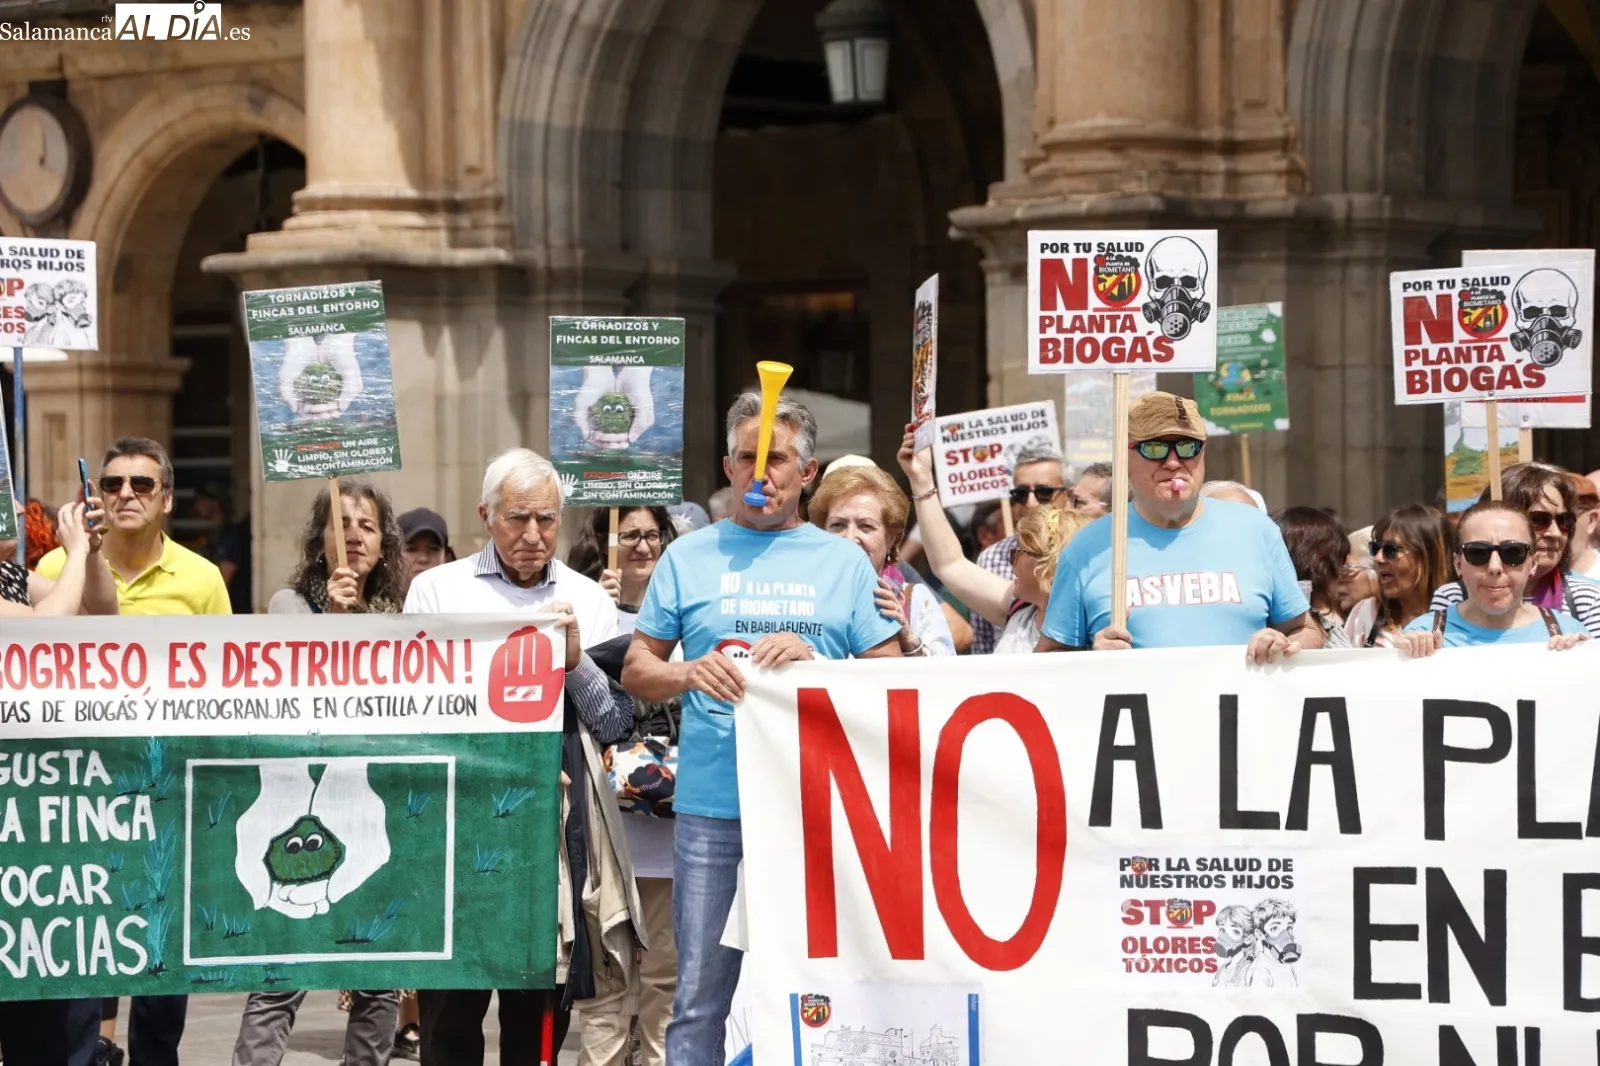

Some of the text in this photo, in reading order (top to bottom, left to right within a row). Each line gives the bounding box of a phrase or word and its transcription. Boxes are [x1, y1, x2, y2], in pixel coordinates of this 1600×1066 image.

[8, 245, 60, 258] SALUD
[65, 248, 85, 259] DE
[1040, 242, 1144, 253] POR TU SALUD
[37, 260, 85, 272] HIJOS
[1402, 275, 1511, 292] POR TU SALUD
[269, 288, 357, 304] TORNADIZOS Y
[251, 300, 380, 319] FINCAS DEL ENTORNO
[288, 323, 346, 335] SALAMANCA
[575, 321, 660, 331] TORNADIZOS Y
[1039, 314, 1137, 334] PLANTA
[556, 335, 680, 345] FINCAS DEL ENTORNO
[1039, 331, 1175, 364] BIOGÁS
[589, 355, 644, 364] SALAMANCA
[1405, 344, 1505, 367] PLANTA
[1406, 358, 1546, 395] BIOGÁS
[969, 417, 984, 428] LA
[987, 412, 1027, 426] SALUD
[1031, 409, 1046, 418] DE
[942, 420, 1048, 444] NUESTROS HIJOS
[358, 438, 378, 446] AIRE
[333, 451, 349, 460] SIN
[351, 448, 385, 458] OLORES
[316, 456, 393, 471] CONTAMINACIÓN
[948, 465, 1008, 484] OLORES
[583, 490, 674, 499] SIN CONTAMINACIÓN
[720, 571, 816, 598] NO A LA PLANTA
[1126, 571, 1242, 608] ASVEBA
[721, 599, 815, 616] DE BIOMETANO
[735, 620, 823, 636] EN BABILAFUENTE
[168, 641, 207, 688] ES
[42, 701, 65, 722] DE
[75, 695, 137, 721] BIOGÁS
[145, 698, 159, 721] Y
[162, 698, 300, 720] MACROGRANJAS
[313, 696, 337, 718] EN
[343, 695, 417, 718] CASTILLA
[422, 695, 434, 715] Y
[438, 694, 477, 716] LEON
[39, 795, 156, 843] FINCA
[797, 687, 1600, 971] NO A LA PL
[1166, 858, 1190, 872] LA
[1196, 857, 1261, 872] SALUD
[1268, 858, 1293, 872] DE
[1120, 874, 1294, 889] NUESTROS HIJOS
[1121, 936, 1217, 955] OLORES
[1353, 867, 1507, 1006] EN
[1122, 954, 1218, 974] TÓXICOS
